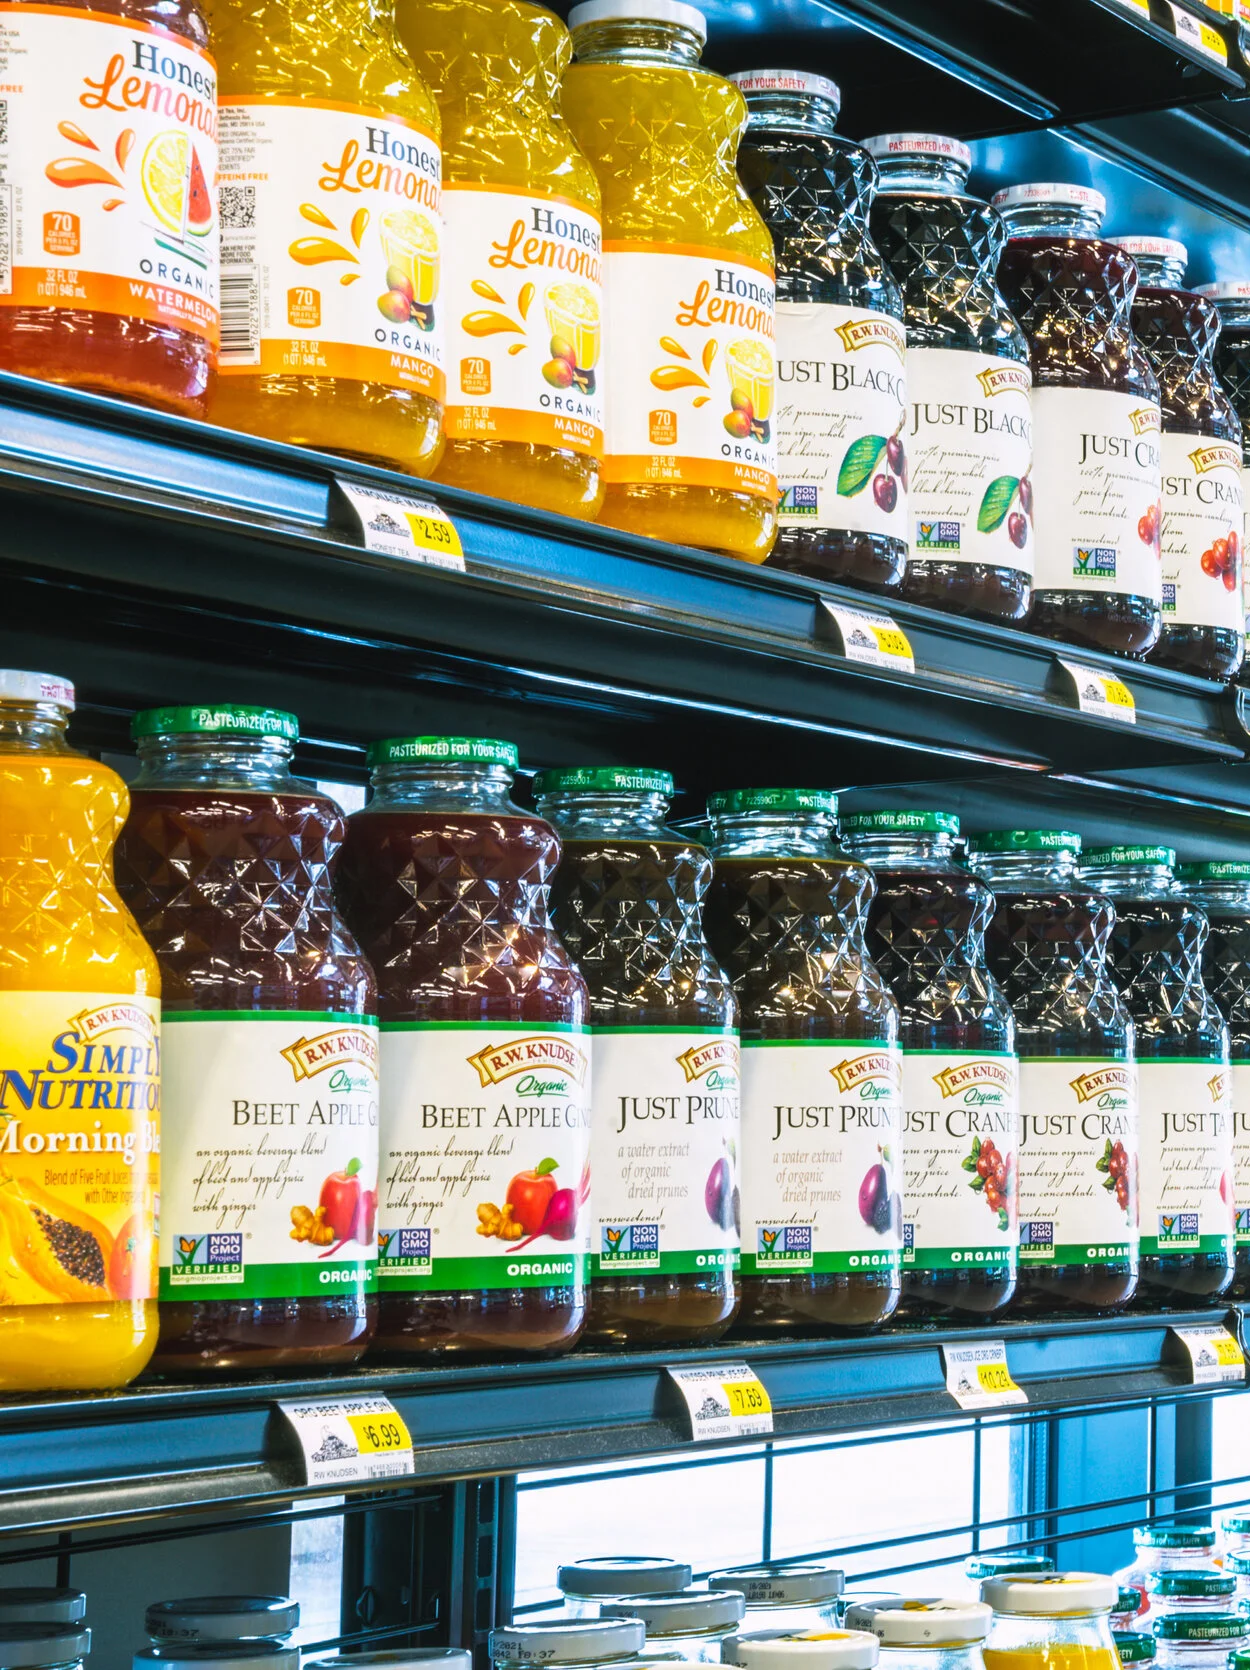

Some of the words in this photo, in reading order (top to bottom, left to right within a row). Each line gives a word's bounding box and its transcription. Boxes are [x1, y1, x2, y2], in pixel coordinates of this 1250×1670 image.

[132, 40, 216, 105] Honest
[753, 78, 776, 89] YOUR
[778, 78, 806, 90] SAFETY
[888, 139, 938, 151] PASTEURIZED
[365, 126, 441, 183] Honest
[248, 173, 269, 182] FREE
[52, 214, 73, 232] 70
[531, 207, 601, 255] Honest
[140, 259, 214, 300] ORGANIC
[714, 268, 775, 310] Honest
[129, 283, 217, 325] WATERMELON
[295, 289, 313, 305] 70
[374, 328, 441, 362] ORGANIC
[390, 354, 434, 379] MANGO
[468, 359, 484, 374] 70
[832, 362, 897, 396] BLACK
[539, 394, 601, 423] ORGANIC
[655, 412, 671, 426] 70
[911, 403, 969, 436] JUST
[973, 407, 1027, 438] BLACK
[554, 418, 595, 439] MANGO
[721, 443, 775, 469] ORGANIC
[1078, 433, 1131, 465] JUST
[734, 466, 770, 486] MANGO
[795, 486, 816, 494] NON
[795, 493, 817, 501] GMO
[415, 517, 451, 545] $2.59
[939, 529, 960, 537] GMO
[940, 522, 959, 530] NON
[917, 541, 960, 549] VERIFIED
[1096, 548, 1115, 557] NON
[1096, 556, 1115, 564] GMO
[1075, 568, 1115, 577] VERIFIED
[198, 712, 267, 730] PASTEURIZED
[389, 743, 449, 758] PASTEURIZED
[451, 742, 470, 756] FOR
[472, 743, 495, 757] YOUR
[614, 775, 662, 791] PASTEURIZED
[873, 815, 896, 825] YOUR
[896, 815, 926, 827] SAFETY
[1111, 850, 1125, 861] FOR
[1127, 849, 1144, 860] YOUR
[1145, 848, 1167, 860] SAFETY
[47, 1031, 161, 1075] SIMPLY
[491, 1047, 524, 1071] R.W.
[515, 1074, 570, 1098] Organic
[963, 1087, 1004, 1104] Organic
[233, 1100, 300, 1126] BEET
[307, 1099, 365, 1126] APPLE
[422, 1104, 487, 1129] BEET
[493, 1104, 561, 1129] APPLE
[616, 1096, 680, 1134] JUST
[685, 1096, 740, 1125] PRUNE
[772, 1105, 834, 1141] JUST
[1019, 1113, 1077, 1148] JUST
[1160, 1112, 1207, 1144] JUST
[0, 1120, 137, 1166] Morning
[627, 1143, 656, 1158] water
[658, 1142, 690, 1158] extract
[782, 1150, 809, 1164] water
[811, 1149, 843, 1164] extract
[44, 1168, 68, 1186] Blend
[79, 1168, 94, 1185] Five
[95, 1168, 110, 1185] Fruit
[621, 1163, 633, 1179] of
[633, 1163, 671, 1184] organic
[776, 1168, 787, 1184] of
[787, 1168, 824, 1189] organic
[627, 1182, 655, 1200] dried
[656, 1185, 689, 1205] prunes
[782, 1186, 809, 1204] dried
[810, 1188, 842, 1207] prunes
[598, 1206, 665, 1224] unsweetened
[755, 1210, 818, 1225] unsweetened
[1180, 1214, 1198, 1222] NON
[632, 1225, 657, 1235] NON
[786, 1228, 810, 1237] NON
[1030, 1222, 1052, 1231] NON
[1180, 1221, 1198, 1229] GMO
[210, 1235, 240, 1245] NON
[401, 1230, 429, 1240] NON
[632, 1234, 657, 1244] GMO
[786, 1235, 810, 1244] GMO
[1030, 1229, 1053, 1238] GMO
[1160, 1234, 1198, 1242] VERIFIED
[209, 1244, 241, 1254] GMO
[401, 1239, 429, 1249] GMO
[632, 1243, 657, 1252] Project
[209, 1253, 241, 1264] Project
[401, 1248, 430, 1257] Project
[604, 1251, 657, 1261] VERIFIED
[759, 1251, 810, 1260] VERIFIED
[951, 1250, 1012, 1263] ORGANIC
[174, 1263, 241, 1275] VERIFIED
[379, 1257, 429, 1267] ERIFIED
[507, 1262, 573, 1277] ORGANIC
[318, 1269, 373, 1284] ORGANIC
[733, 1387, 763, 1409] $7.69
[363, 1423, 401, 1448] $6.99
[707, 1424, 731, 1434] KNUDSEN
[314, 1470, 325, 1480] RW
[326, 1467, 358, 1479] KNUDSEN
[1189, 1628, 1229, 1638] PASTEURIZED
